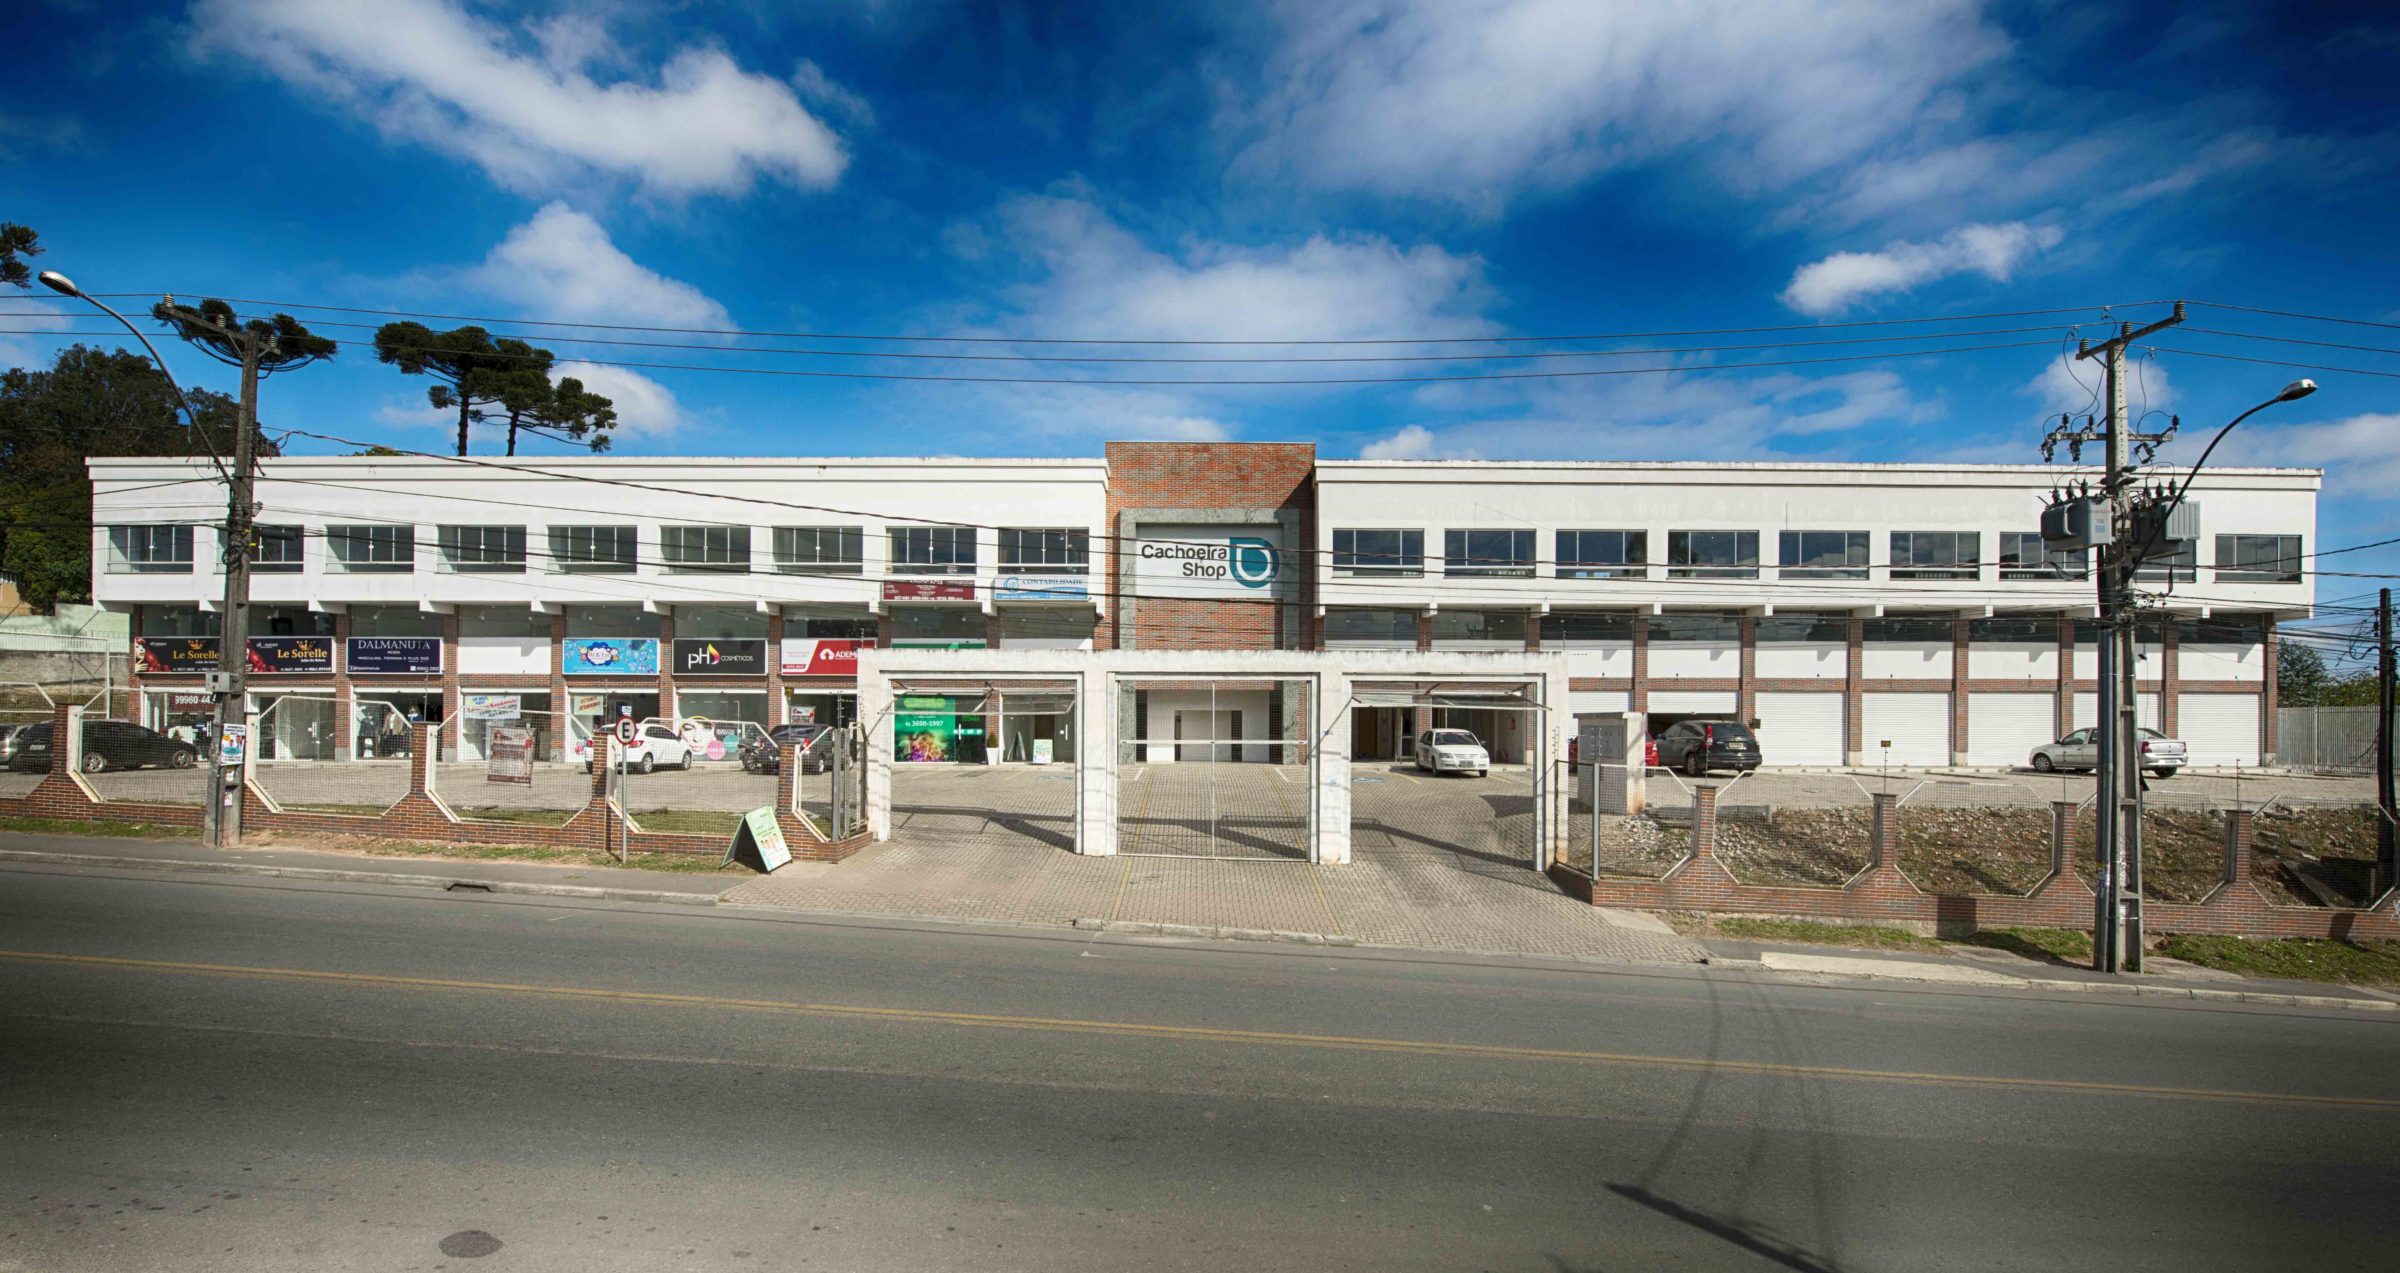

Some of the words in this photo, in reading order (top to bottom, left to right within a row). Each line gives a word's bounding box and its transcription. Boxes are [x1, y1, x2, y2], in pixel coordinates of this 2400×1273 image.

[1141, 544, 1227, 560] Cachoeira
[1182, 562, 1227, 580] Shop
[358, 640, 430, 649] DALMANUTA
[172, 650, 185, 659] Le
[187, 650, 220, 659] Sorelle
[277, 649, 290, 658] Le
[291, 648, 328, 658] Sorelle
[688, 647, 710, 670] pH
[834, 650, 858, 658] ADEM
[621, 721, 631, 739] E
